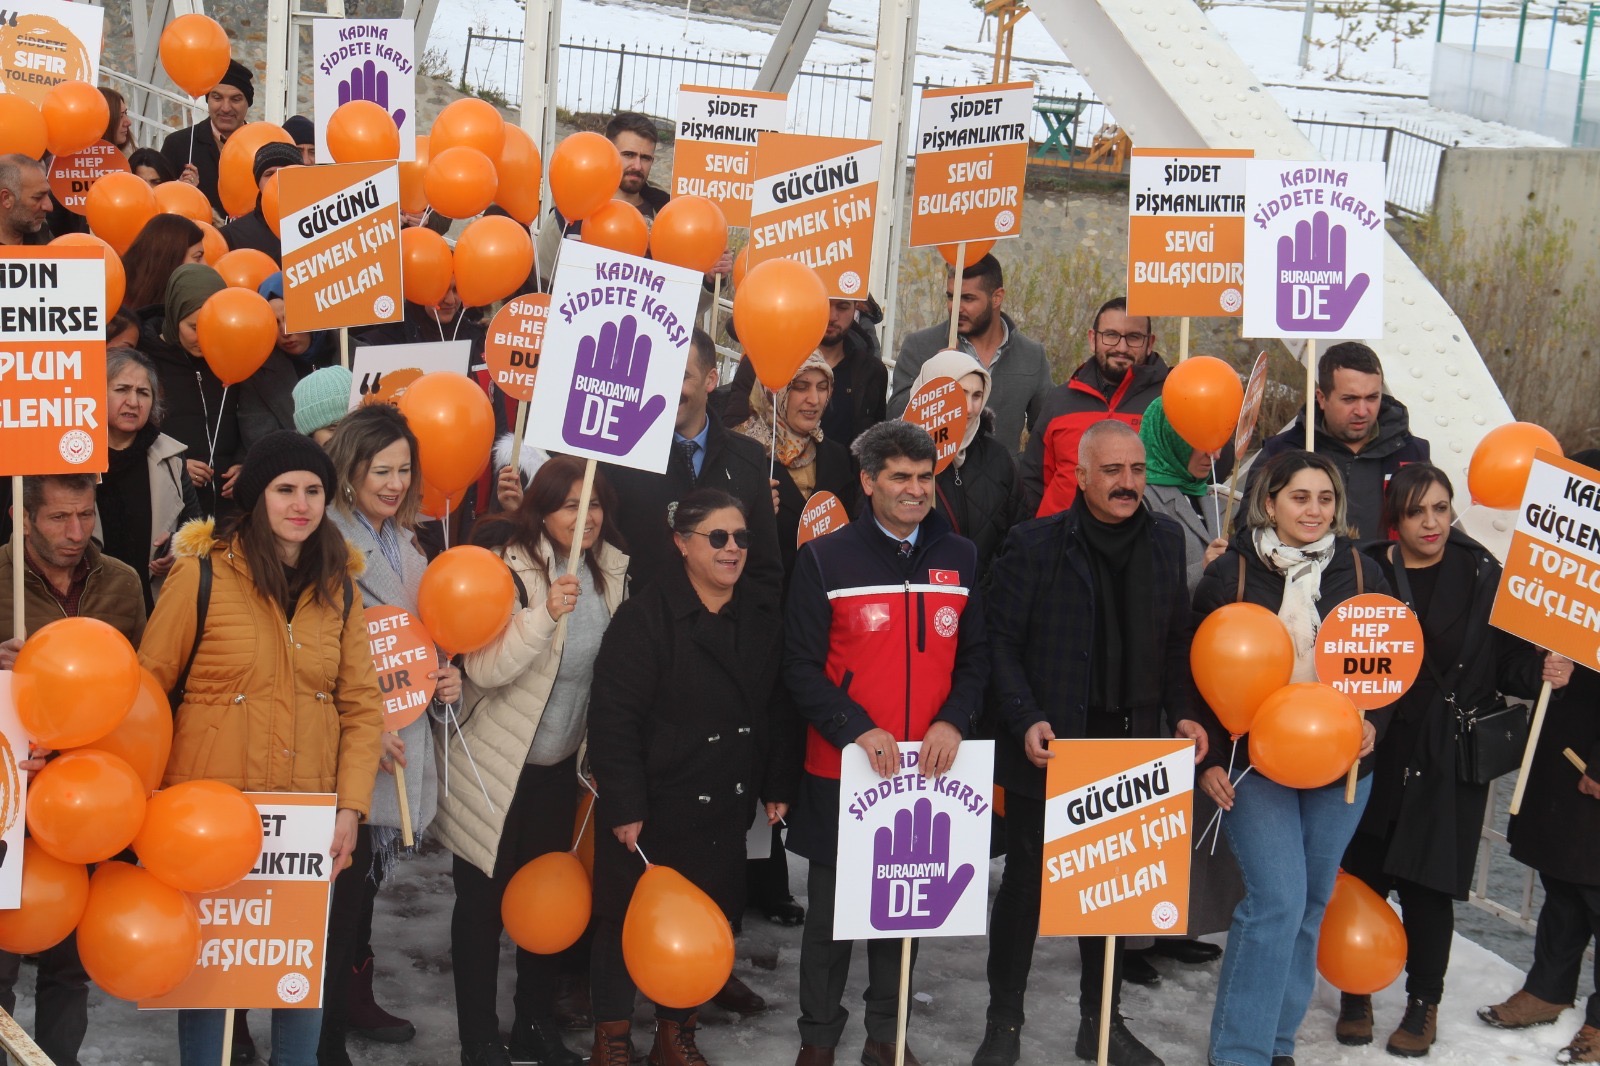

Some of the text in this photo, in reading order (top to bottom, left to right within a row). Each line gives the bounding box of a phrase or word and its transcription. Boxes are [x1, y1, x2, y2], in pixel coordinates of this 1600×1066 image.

[339, 25, 388, 41] KADINA
[14, 51, 66, 74] SIFIR
[320, 42, 412, 75] ŞİDDETE KARŞI
[5, 69, 68, 86] TOLERAN
[707, 95, 758, 118] ŞİDDET
[950, 95, 1003, 122] ŞİDDET
[681, 117, 779, 142] PİŞMANLIK
[922, 123, 1025, 151] PİŞMANLIKTIR
[55, 169, 124, 178] BİRLİK
[75, 158, 103, 167] HEP
[705, 151, 749, 175] SEVGİ
[947, 152, 993, 184] SEVGİ
[1164, 158, 1221, 186] ŞİDDET
[677, 177, 754, 202] BULAŞICID
[772, 156, 859, 204] GÜCÜNÜ
[1280, 168, 1348, 188] KADINA
[298, 180, 380, 239] GÜCÜNÜ
[918, 185, 1018, 216] BULAŞICIDIR
[1136, 187, 1245, 215] PİŞMANLIKTIR
[1253, 189, 1381, 231] ŞİDDETE KARŞI
[753, 194, 871, 250] SEVMEK İÇİN
[1165, 223, 1214, 252] SEVGİ
[286, 218, 395, 289] SEVMEK İÇİN
[0, 263, 57, 288] DIN
[314, 262, 384, 313] KULLAN
[596, 262, 666, 293] KADINA
[1134, 261, 1244, 289] BULAŞICIDIR
[1280, 270, 1342, 284] BURADAYIM
[0, 297, 98, 335] ENİRSE
[509, 301, 549, 318] ŞİDDE
[1292, 284, 1331, 320] DE
[520, 319, 547, 335] HE
[559, 287, 689, 349] ŞİDDETE KARŞI
[494, 332, 543, 350] BİRLİ
[0, 351, 82, 381] PLUM
[510, 350, 540, 369] DU
[498, 369, 535, 387] DİYE
[575, 374, 640, 403] BURADAYIM
[0, 387, 98, 430] LENİR
[911, 381, 956, 412] ŞİDDETE
[921, 400, 945, 420] HEP
[579, 394, 625, 442] DE
[920, 406, 962, 432] LİKTE
[803, 496, 836, 528] ŞİDDETE
[812, 516, 831, 538] HEP
[1526, 503, 1600, 554] GÜÇLEN
[1529, 543, 1600, 594] TOPLU
[1337, 604, 1407, 622] ŞİDDETE
[1508, 575, 1600, 633] GÜÇLEN
[367, 612, 410, 635] DETE
[1351, 623, 1390, 637] HEP
[372, 646, 428, 672] LİKTE
[1324, 638, 1415, 653] BİRLİKTE
[1343, 657, 1392, 674] DUR
[378, 669, 412, 693] UR
[382, 690, 427, 715] ELİM
[848, 773, 989, 822] ŞİDDETE KARŞI
[1066, 761, 1170, 826] GÜCÜNÜ
[1046, 806, 1187, 884] SEVMEK İÇİN
[877, 862, 945, 880] BURADAYIM
[888, 878, 931, 918] DE
[1078, 860, 1168, 915] KULLAN
[199, 888, 273, 926] SEVGİ
[196, 938, 314, 972] AŞICIDIR
